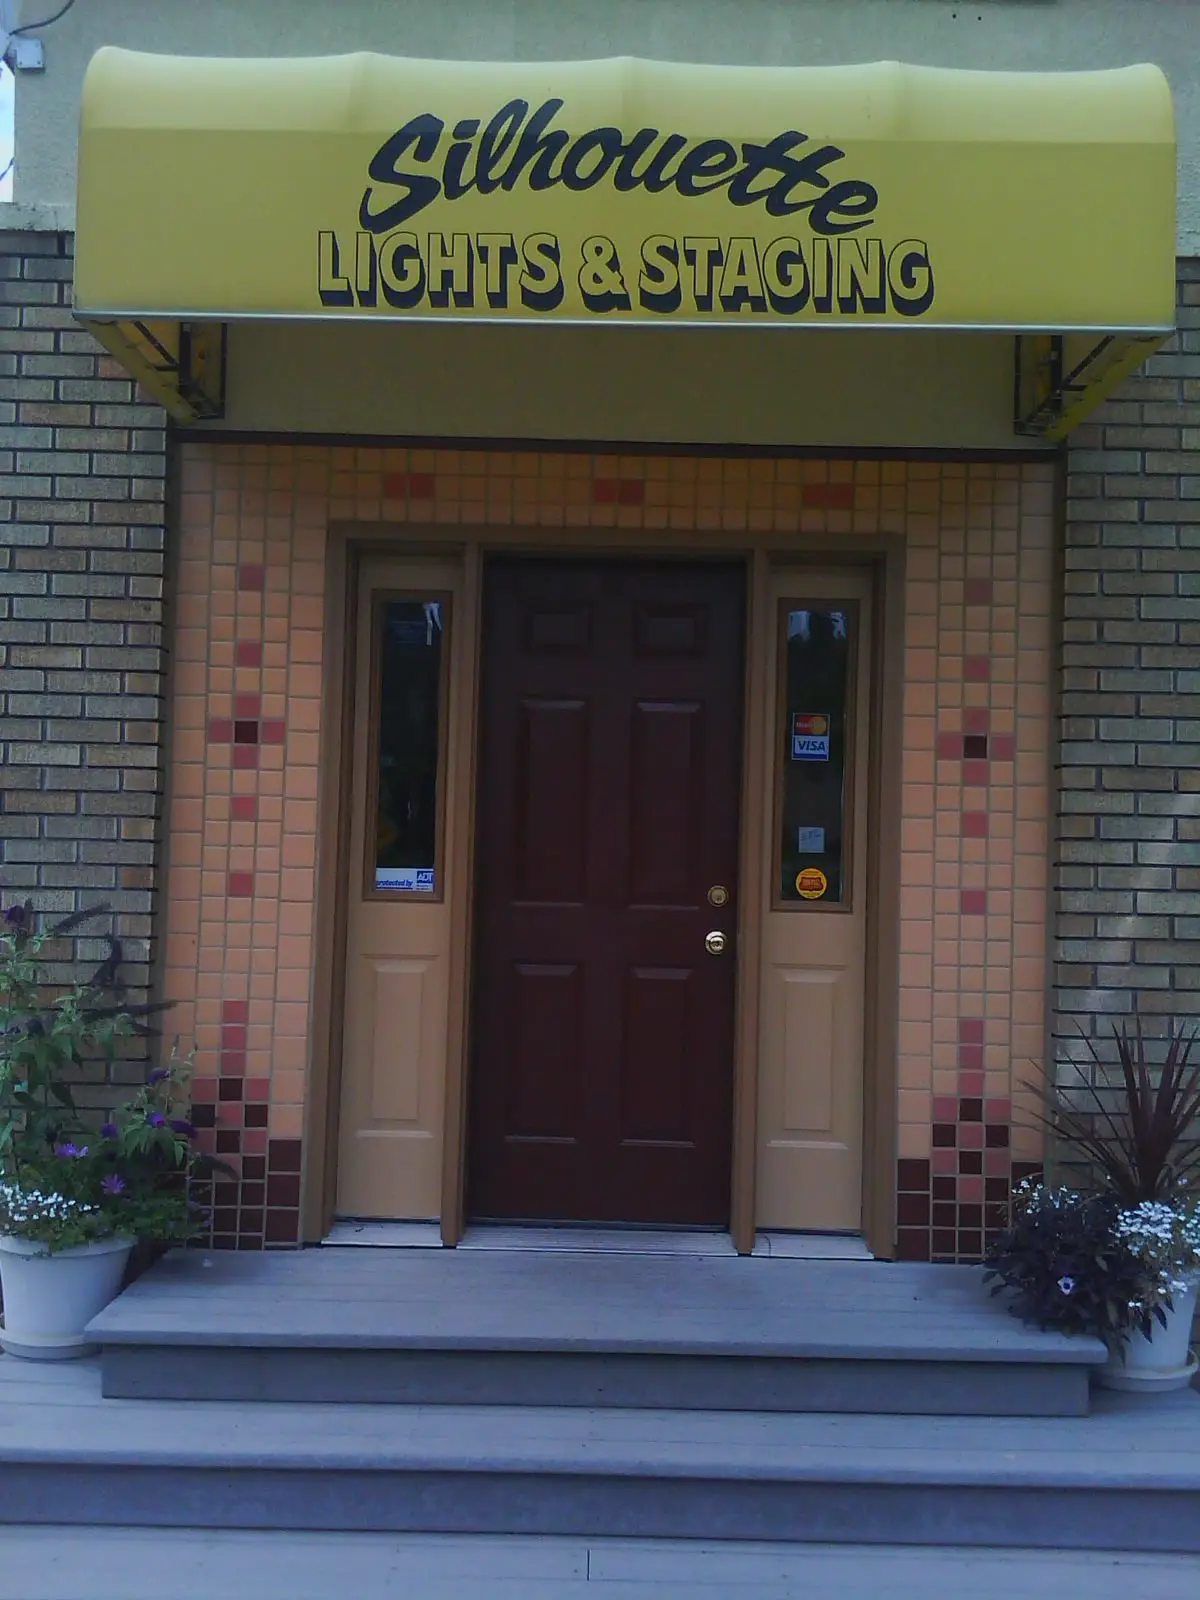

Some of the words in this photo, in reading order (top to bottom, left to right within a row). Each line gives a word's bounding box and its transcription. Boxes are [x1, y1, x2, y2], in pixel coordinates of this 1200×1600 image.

[359, 98, 878, 235] Silhouette
[318, 230, 565, 311] LIGHTS
[578, 235, 632, 312] &
[639, 234, 934, 316] STAGING
[797, 740, 826, 751] VISA
[417, 872, 433, 881] ADT
